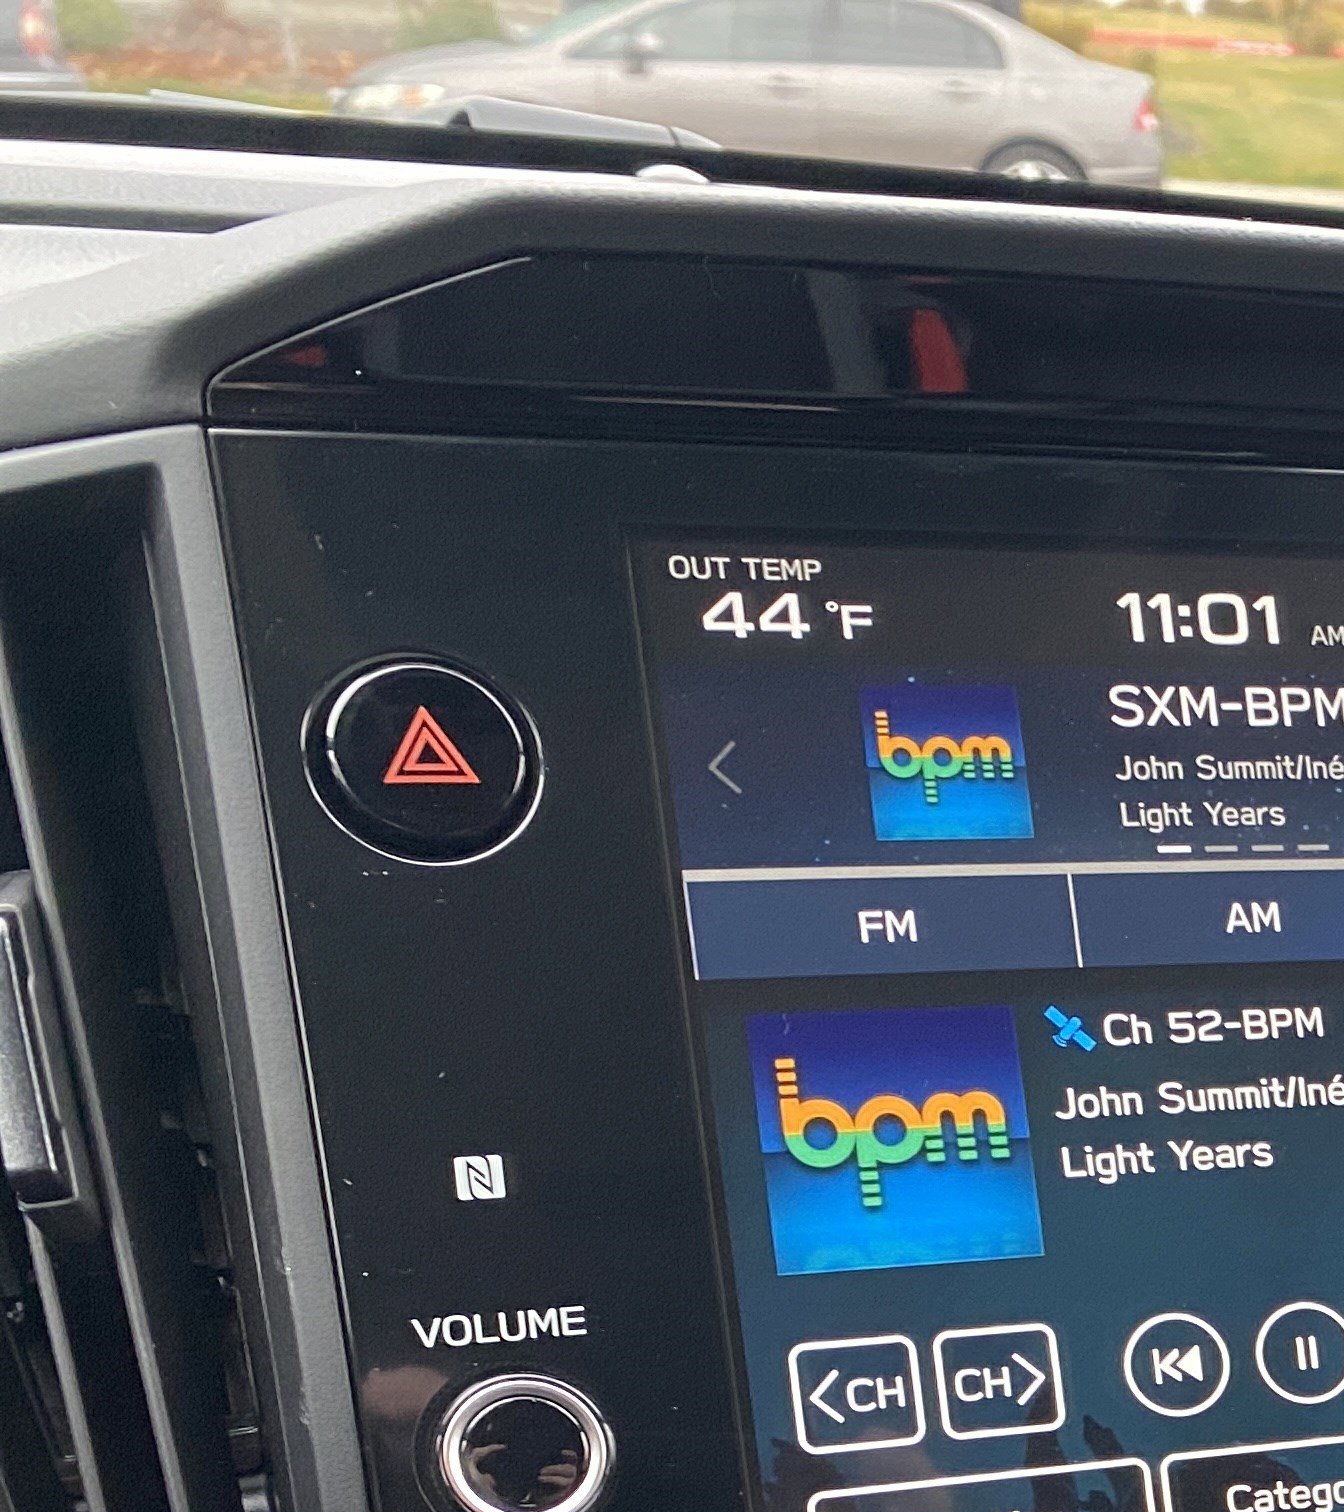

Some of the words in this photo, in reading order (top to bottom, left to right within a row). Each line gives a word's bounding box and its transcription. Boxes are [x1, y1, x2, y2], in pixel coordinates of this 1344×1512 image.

[669, 555, 730, 580] OUT
[741, 556, 823, 582] TEMP
[701, 592, 810, 639] 44
[1115, 592, 1281, 645] 11:01
[874, 710, 1015, 805] bpm
[1115, 755, 1185, 782] John
[1120, 801, 1192, 833] Light
[1202, 801, 1286, 828] Years
[857, 908, 919, 944] FM
[1226, 902, 1282, 934] AM
[1102, 1012, 1153, 1047] Ch
[1168, 1006, 1326, 1044] 52-BPM
[1054, 1086, 1144, 1122] John
[774, 1057, 1007, 1207] bpm
[1060, 1142, 1156, 1184] Light
[1168, 1139, 1274, 1174] Years
[410, 1305, 588, 1349] VOLUME
[846, 1375, 906, 1414] CH
[953, 1365, 1012, 1404] CH
